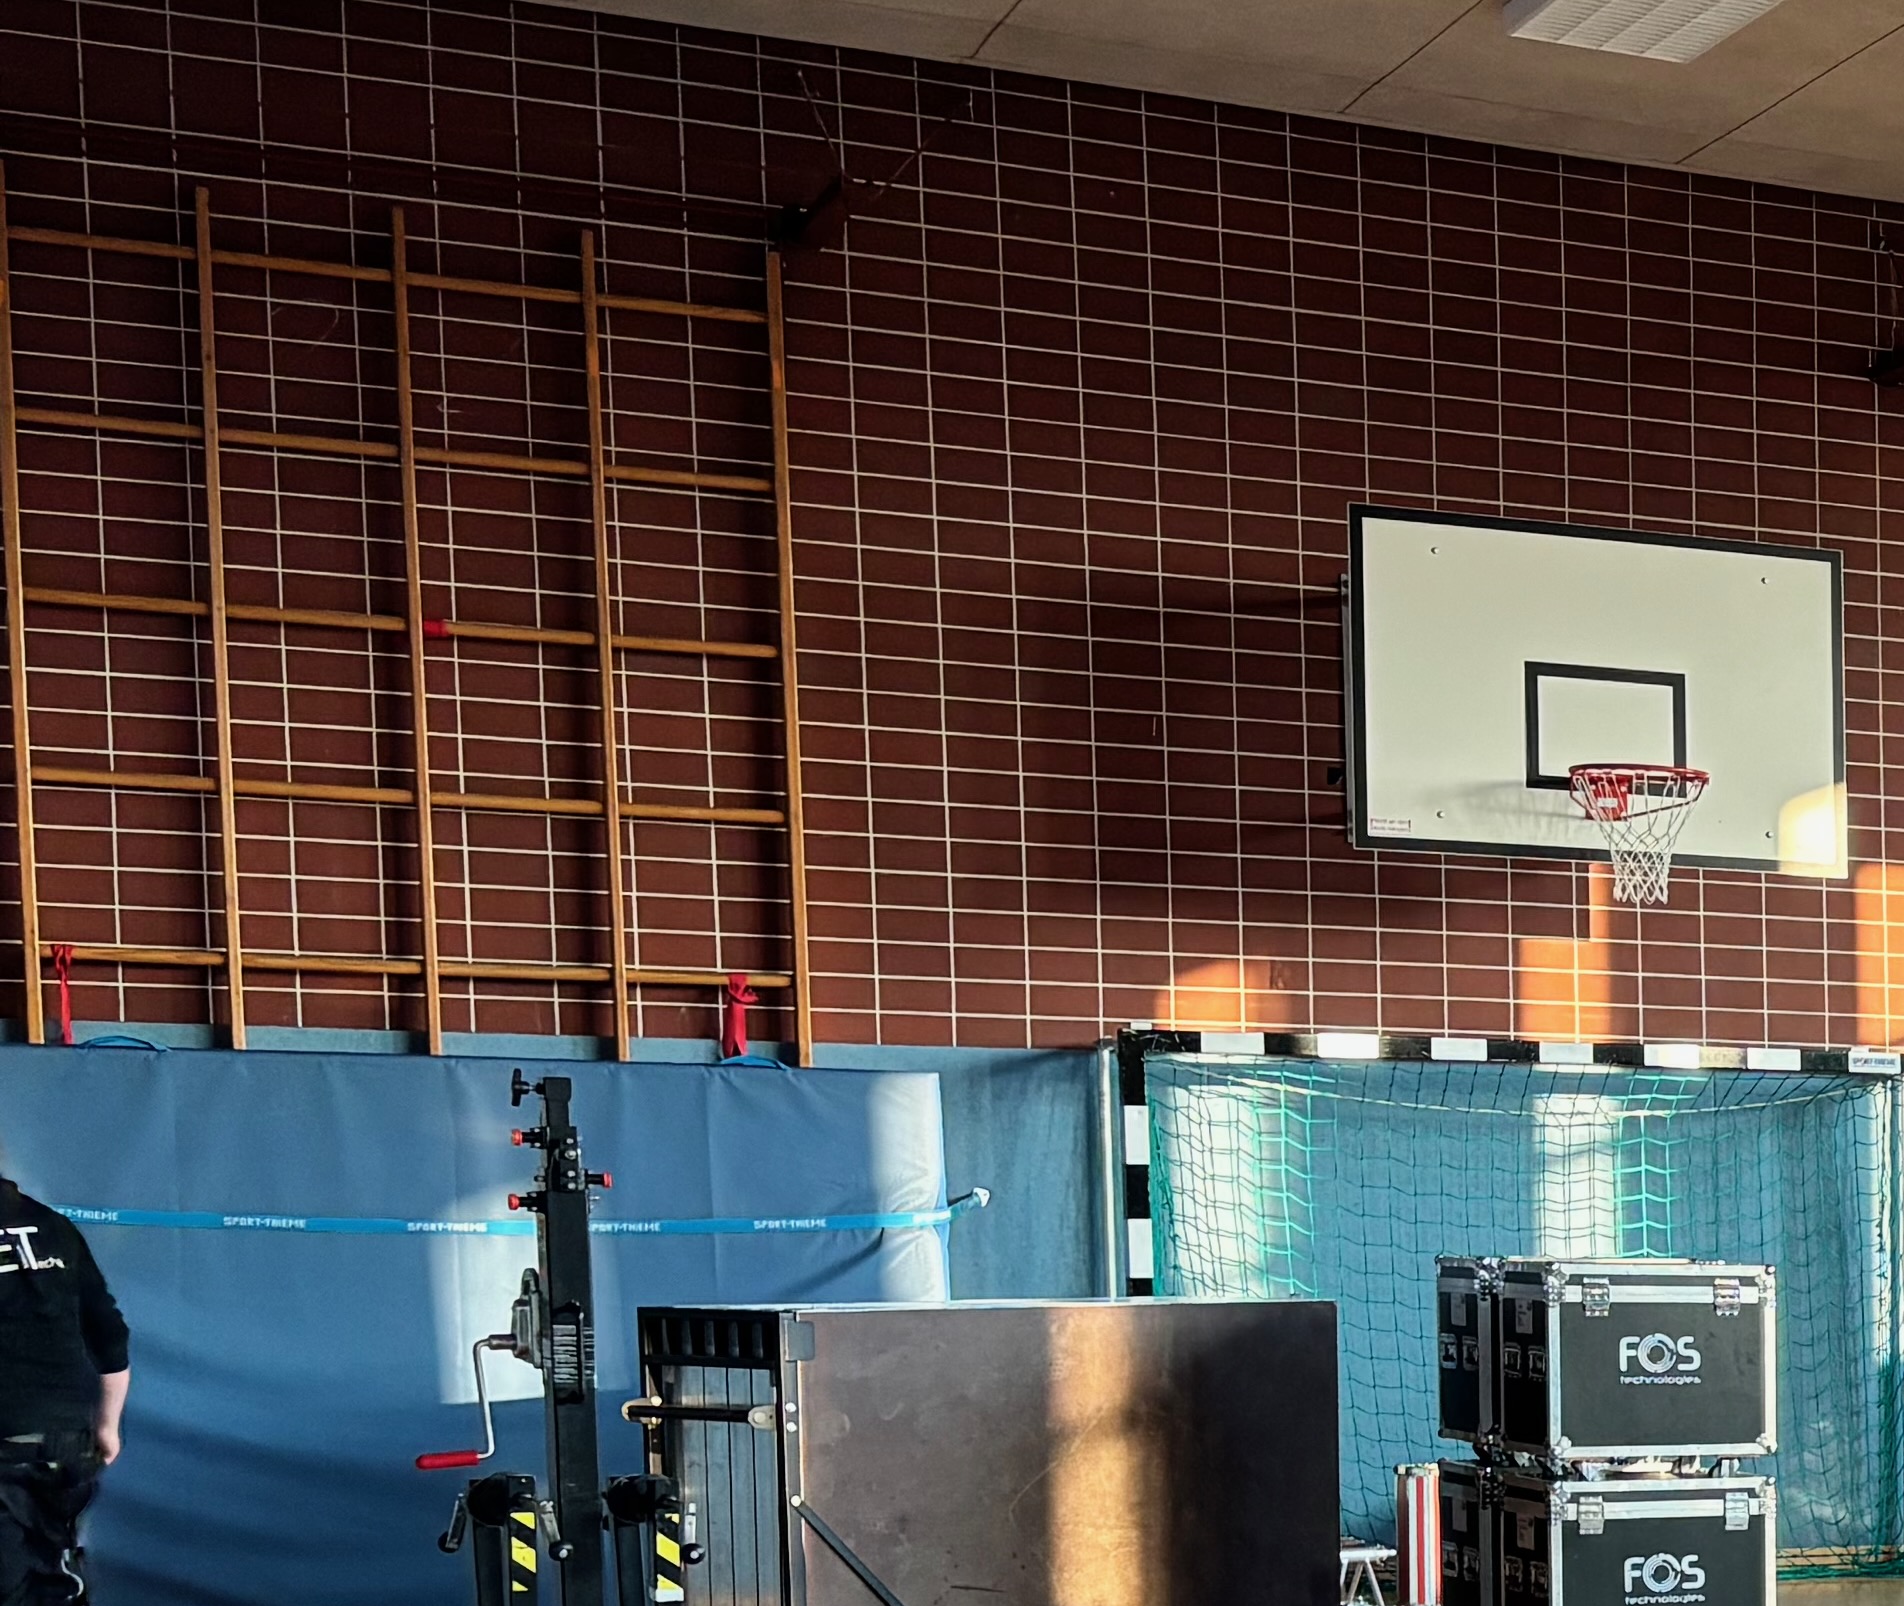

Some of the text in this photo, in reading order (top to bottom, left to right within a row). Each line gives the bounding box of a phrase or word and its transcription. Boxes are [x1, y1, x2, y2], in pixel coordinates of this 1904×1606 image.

[591, 1222, 661, 1232] PORT-THIEME
[1619, 1333, 1701, 1373] FOS
[1620, 1375, 1701, 1386] technologies
[1624, 1553, 1705, 1593] FOS
[1625, 1594, 1705, 1606] technologies
